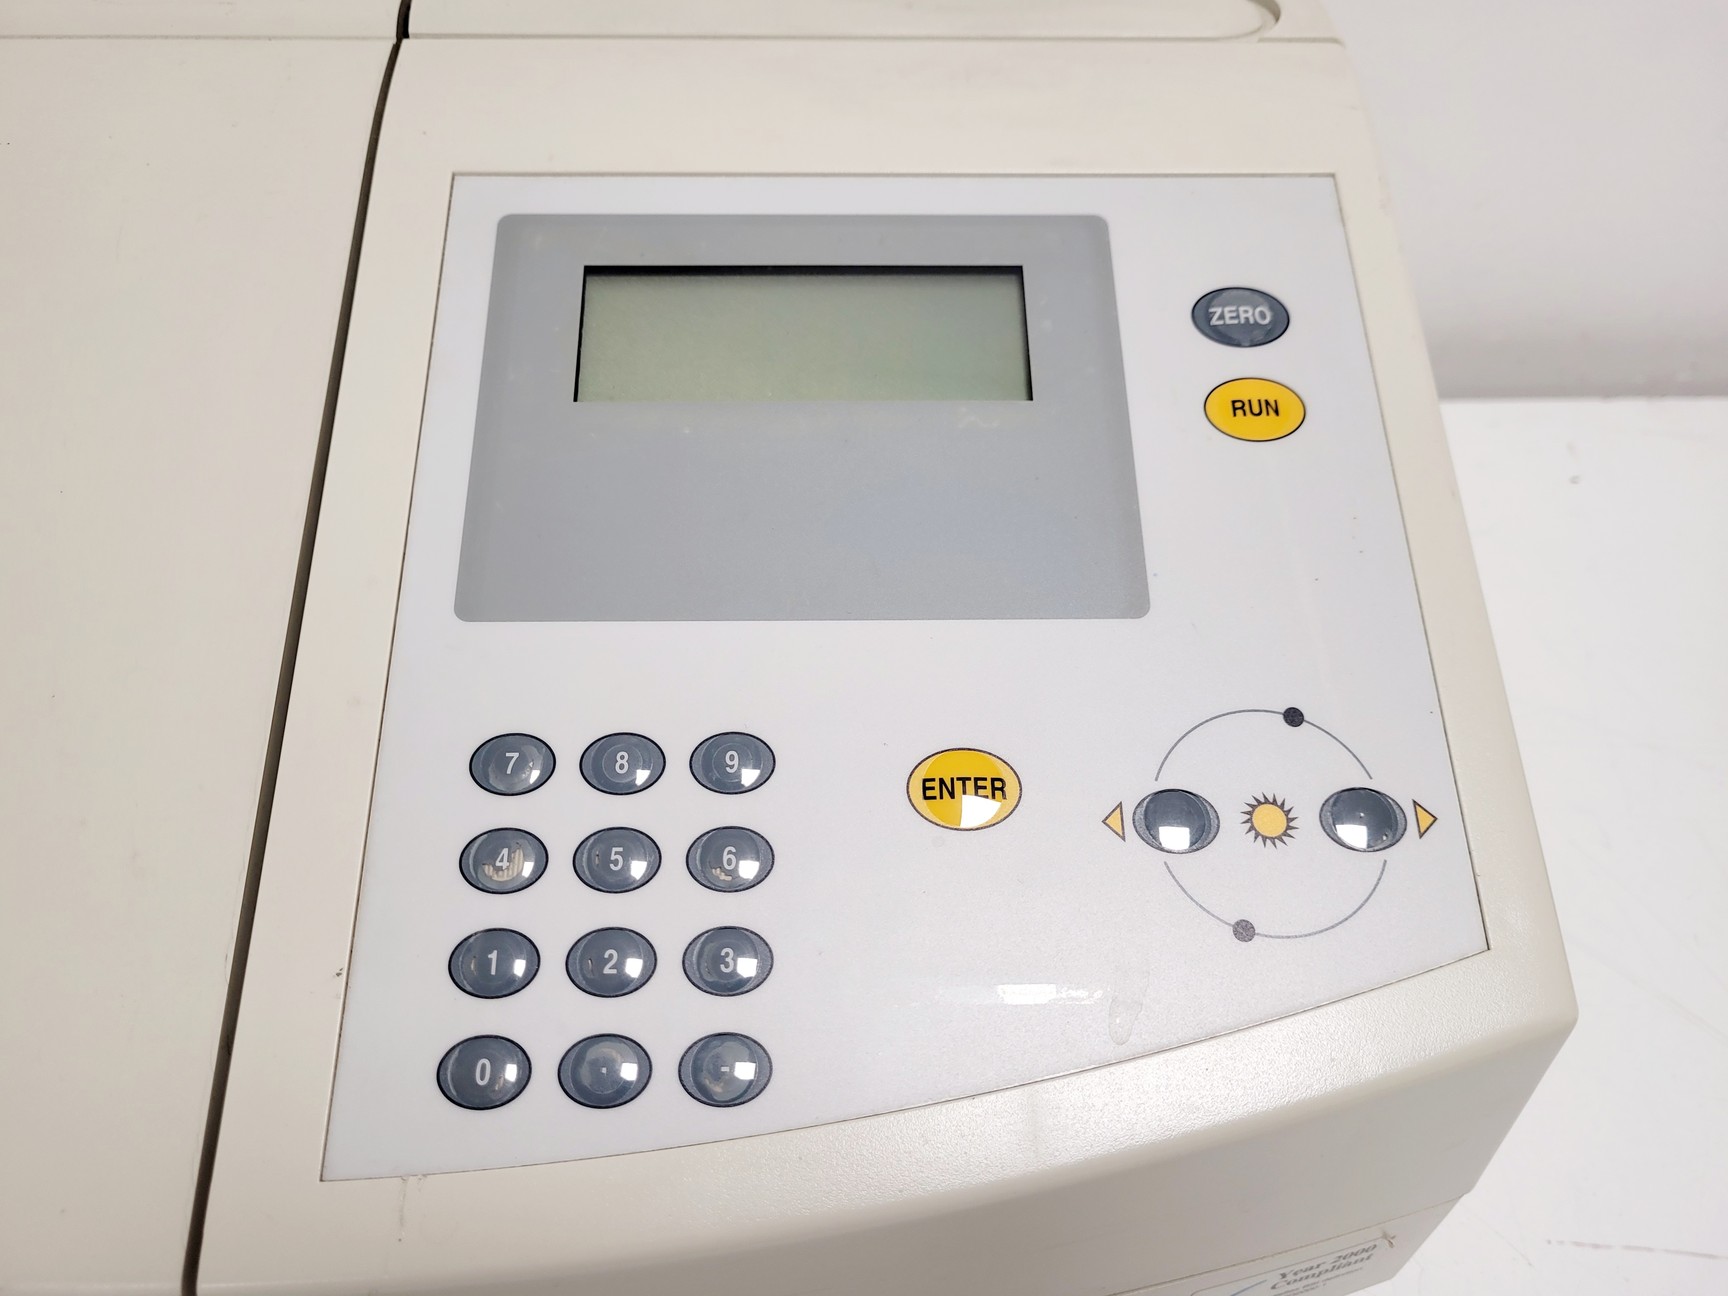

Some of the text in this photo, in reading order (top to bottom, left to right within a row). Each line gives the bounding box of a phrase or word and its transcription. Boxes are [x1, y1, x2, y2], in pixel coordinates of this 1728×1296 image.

[1208, 305, 1272, 325] ZERO
[1231, 399, 1279, 417] RUN
[505, 752, 519, 774] 7
[615, 751, 629, 774] 8
[725, 751, 739, 774] 9
[922, 777, 1006, 800] ENTER
[495, 848, 509, 870] 4
[609, 847, 624, 871] 5
[722, 846, 737, 870] 6
[487, 950, 497, 975] 1
[603, 949, 617, 974] 2
[720, 948, 734, 973] 3
[475, 1058, 491, 1085] 0
[1270, 1253, 1374, 1290] Compliant
[1279, 1244, 1378, 1279] Year 2000
